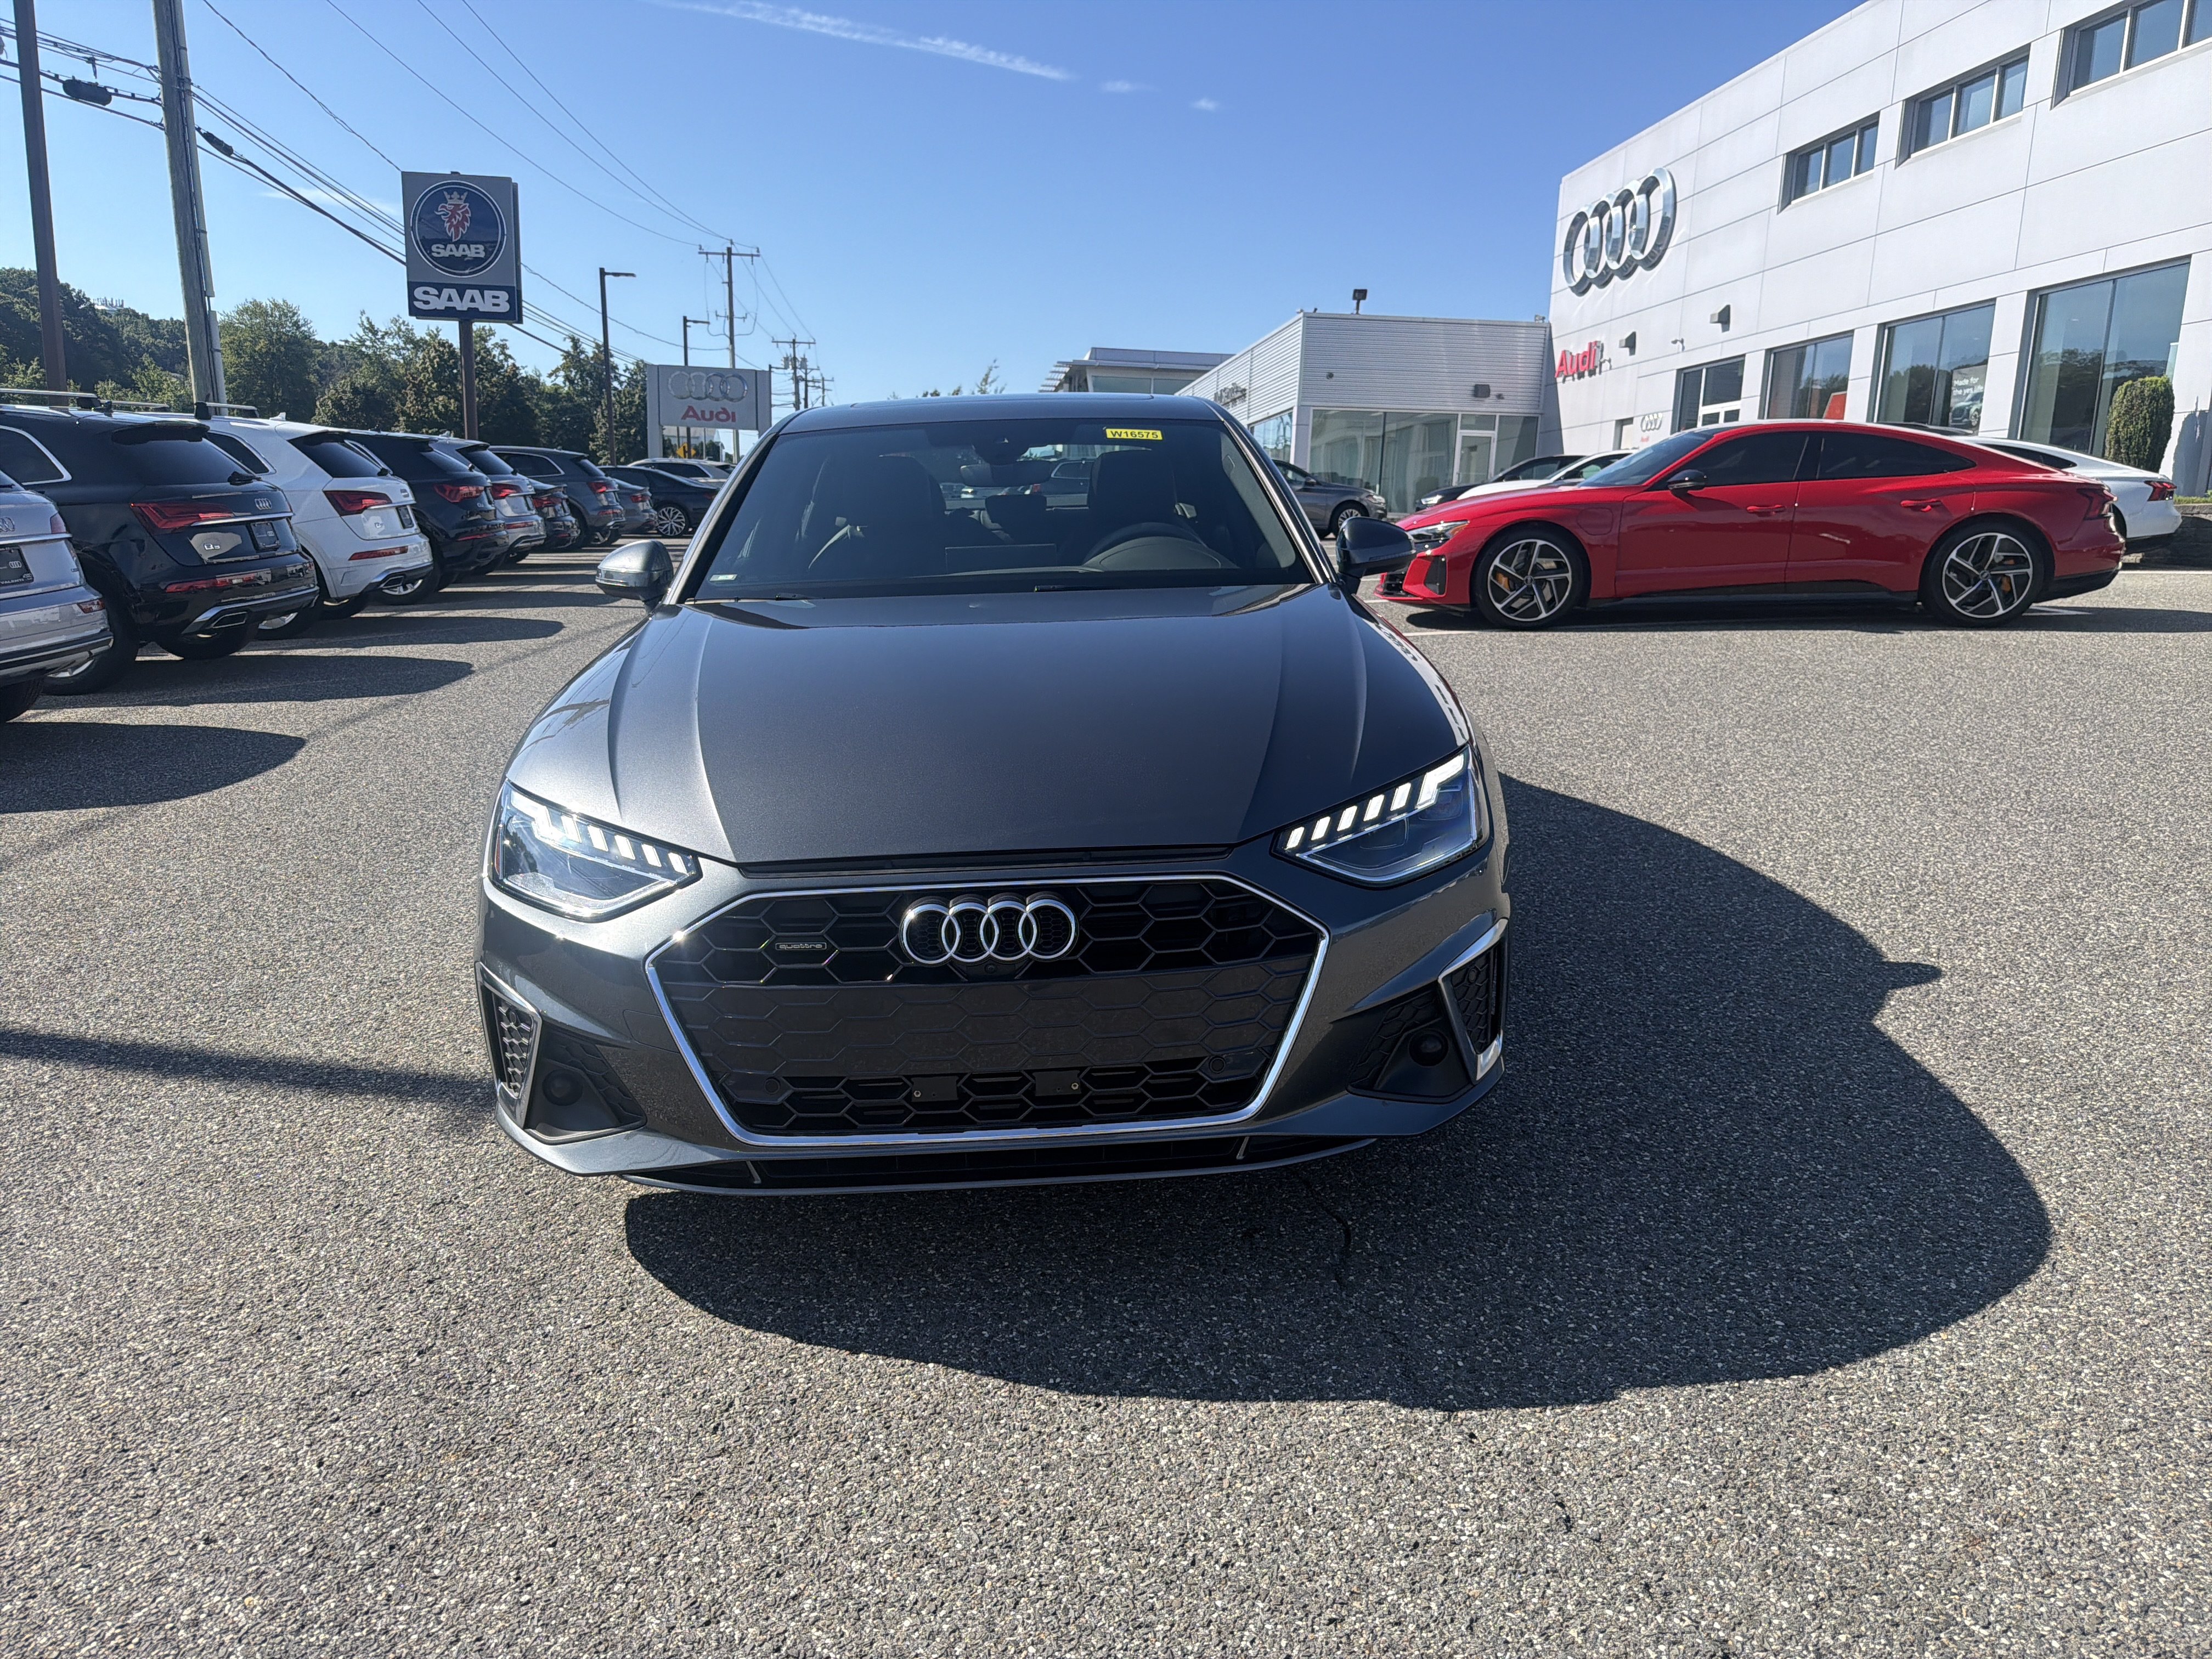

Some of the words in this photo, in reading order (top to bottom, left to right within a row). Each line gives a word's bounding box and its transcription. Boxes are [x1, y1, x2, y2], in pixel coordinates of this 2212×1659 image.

[431, 244, 485, 258] SAAB
[413, 286, 510, 313] SAAB
[1554, 340, 1598, 378] Audi
[681, 405, 737, 423] Audi
[1110, 430, 1159, 438] W16575
